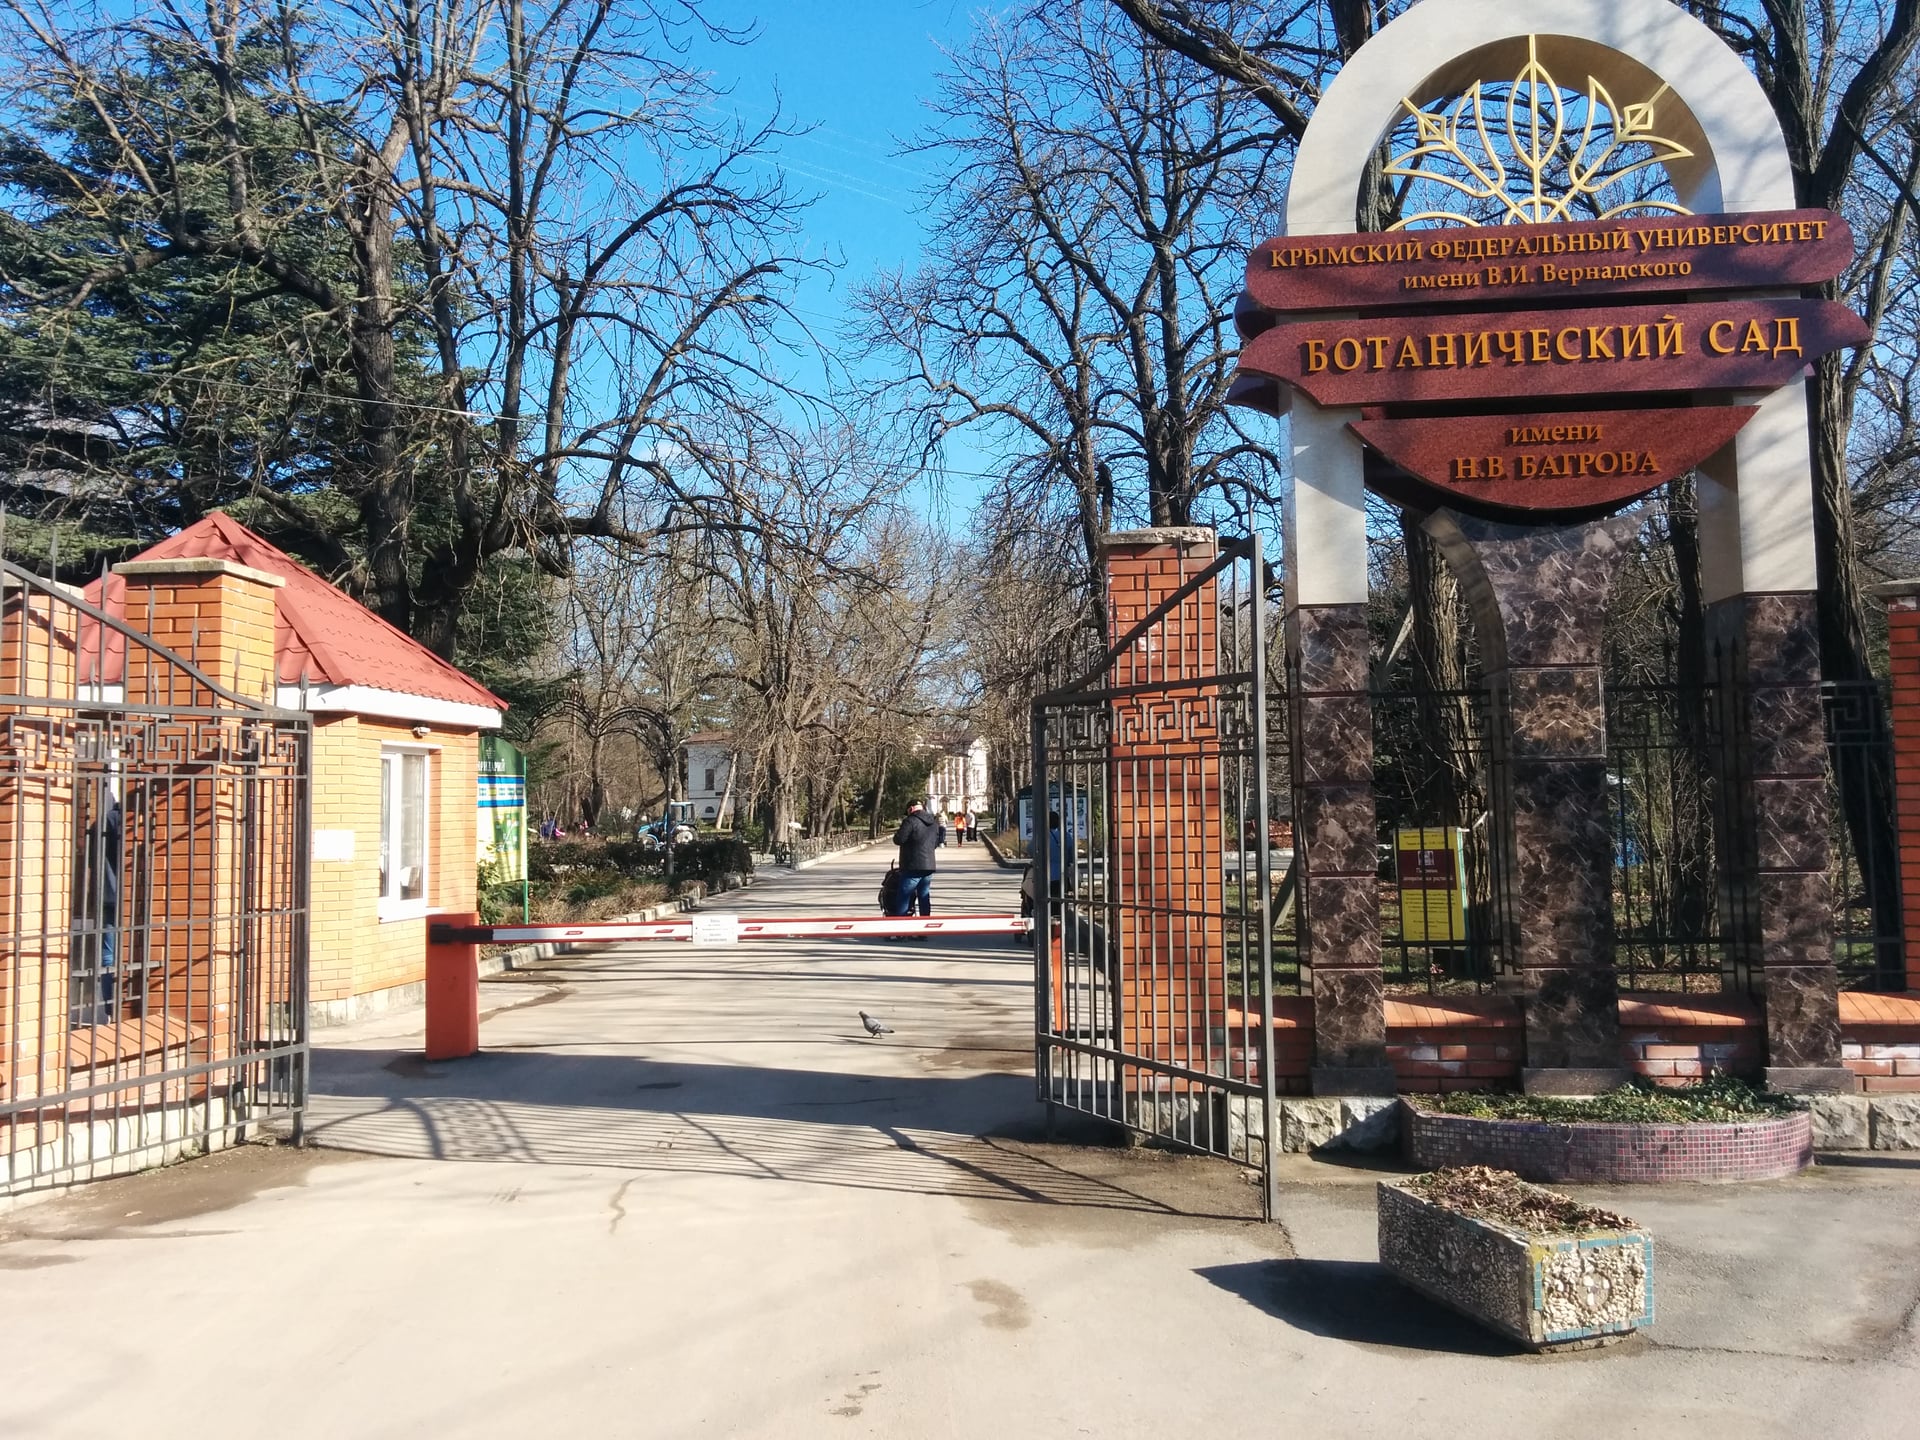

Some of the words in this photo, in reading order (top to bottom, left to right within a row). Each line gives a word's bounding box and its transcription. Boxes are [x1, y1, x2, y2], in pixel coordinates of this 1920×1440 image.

[1271, 237, 1423, 268] КРЫМСКИЙ
[1430, 226, 1630, 261] ФЕДЕРАЛЬНЫЙ
[1637, 220, 1828, 254] УНИВЕРСИТЕТ
[1403, 271, 1481, 290] имени
[1487, 264, 1536, 286] В.И.
[1541, 260, 1693, 287] Вернадского
[1305, 313, 1686, 373] БОТАНИЧЕСКИЙ
[1708, 317, 1803, 361] САД
[1511, 424, 1605, 444] имени
[1519, 451, 1662, 478] БАГРОВА
